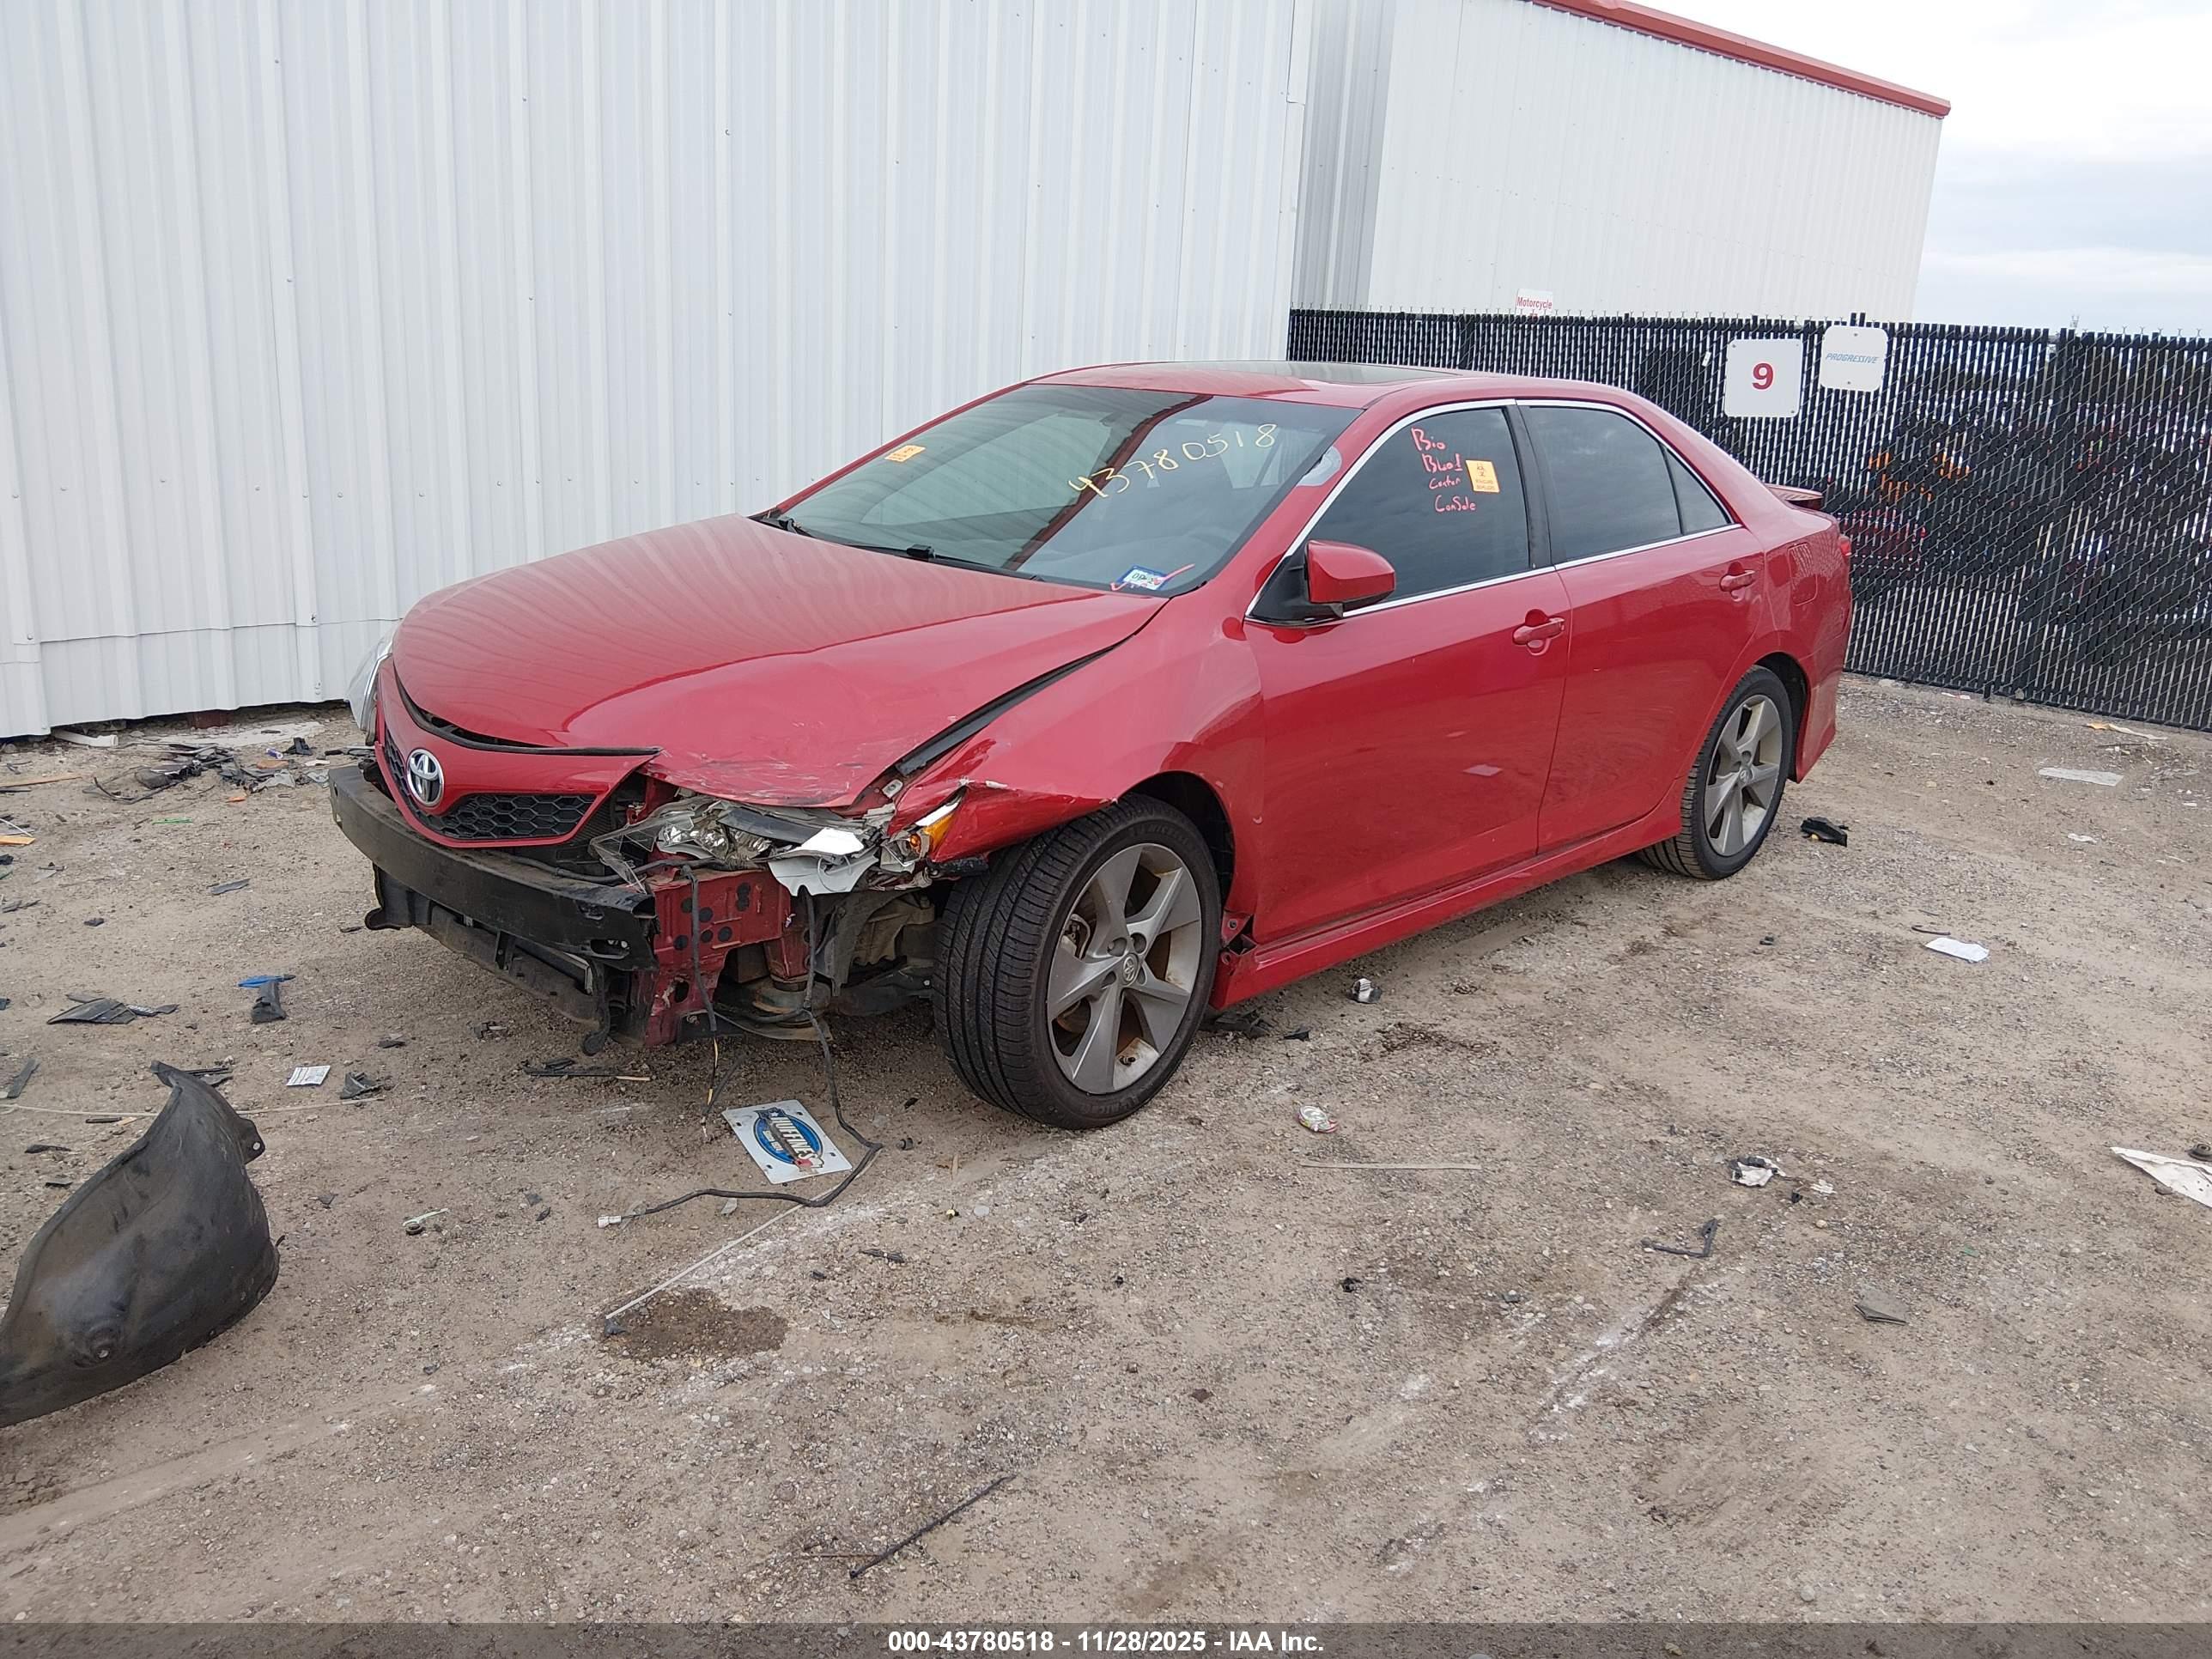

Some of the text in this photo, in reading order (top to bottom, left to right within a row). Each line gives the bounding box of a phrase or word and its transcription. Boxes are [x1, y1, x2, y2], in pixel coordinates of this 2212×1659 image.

[1516, 296, 1553, 310] Motorcycle
[1826, 353, 1880, 364] PROGRESSIVE
[1752, 362, 1774, 390] 9
[1411, 428, 1447, 452] Bio
[1068, 423, 1278, 498] 43780518
[770, 1116, 818, 1160] HUFFINES
